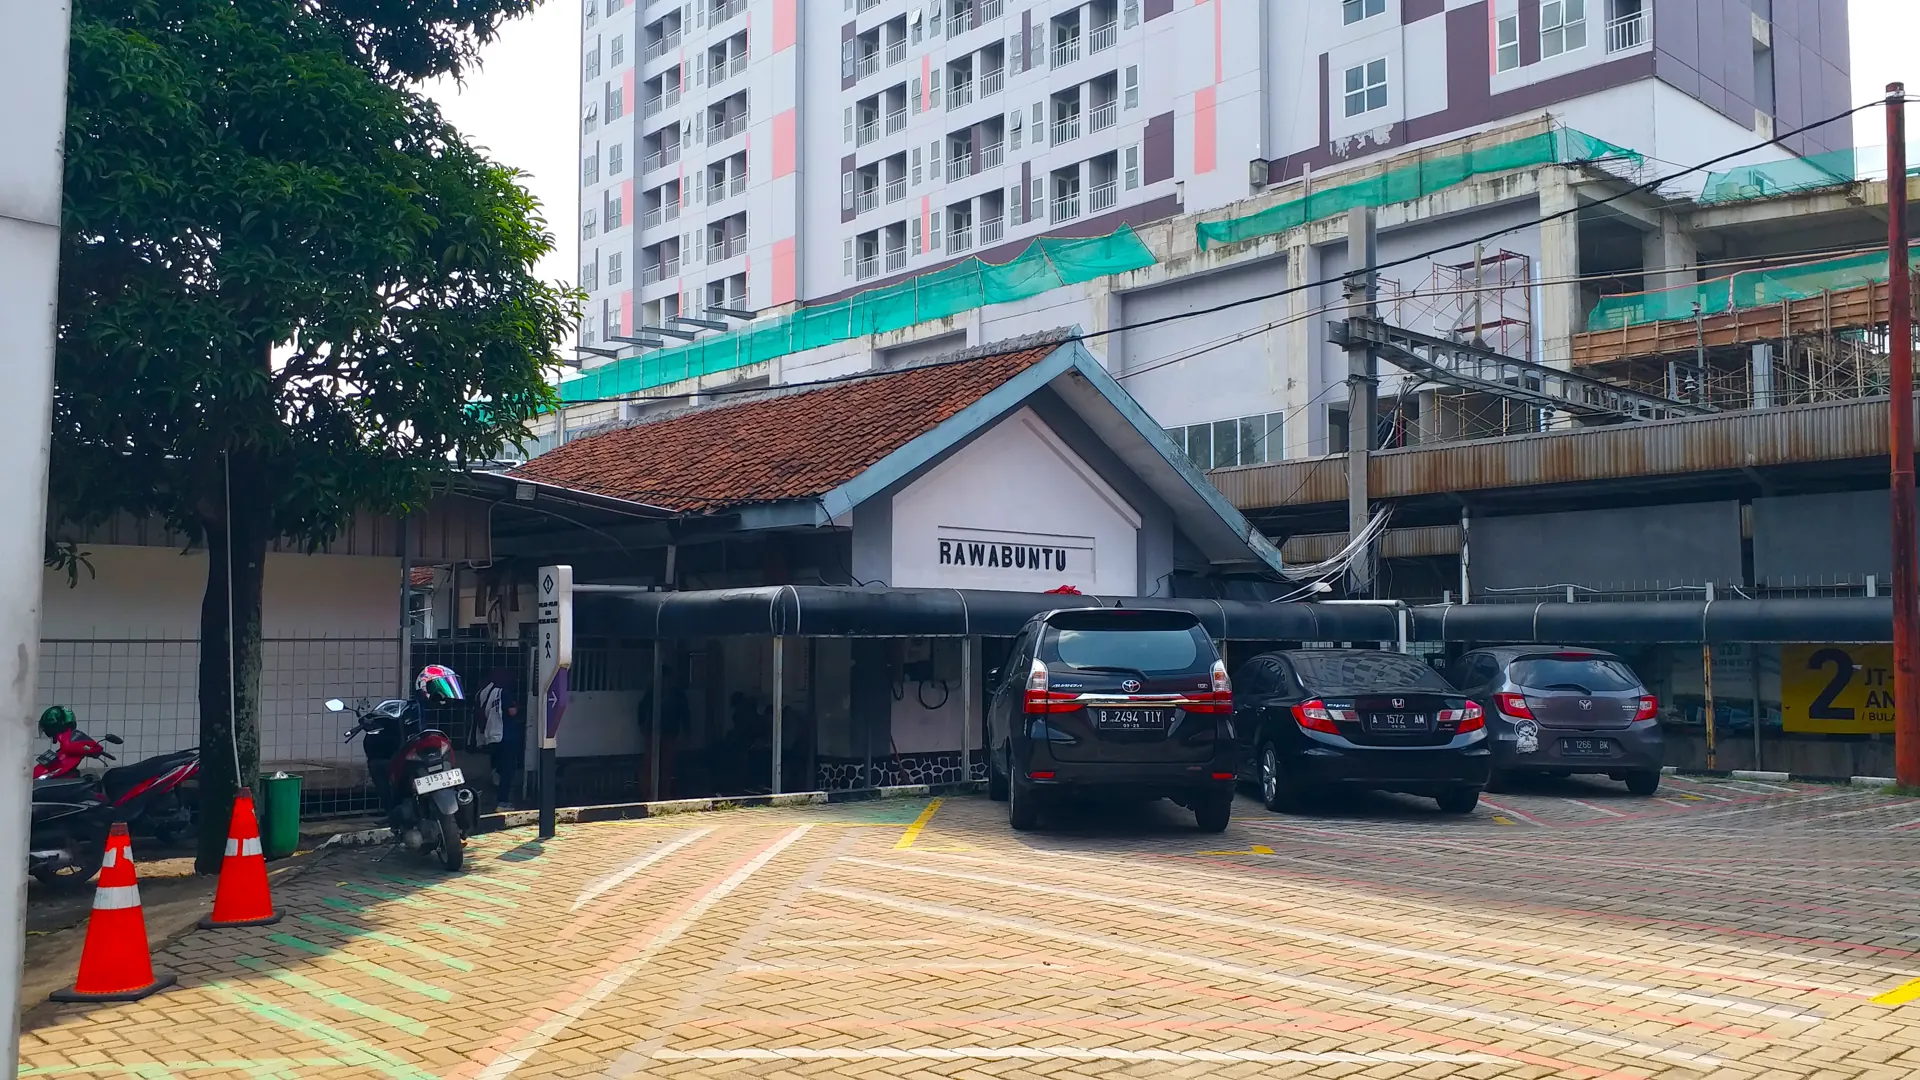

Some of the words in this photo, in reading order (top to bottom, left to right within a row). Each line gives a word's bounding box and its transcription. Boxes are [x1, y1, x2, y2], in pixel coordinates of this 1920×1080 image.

[940, 541, 1066, 572] RAWABUNTU
[1807, 648, 1855, 720] 2
[1101, 711, 1107, 722] B
[1114, 711, 1139, 722] 2494
[1144, 711, 1161, 722] TIY
[1372, 714, 1378, 724] A
[1386, 714, 1405, 724] 1572
[1414, 714, 1425, 724] AM
[1563, 740, 1569, 749] A
[416, 779, 422, 787] B
[424, 773, 444, 784] 3153
